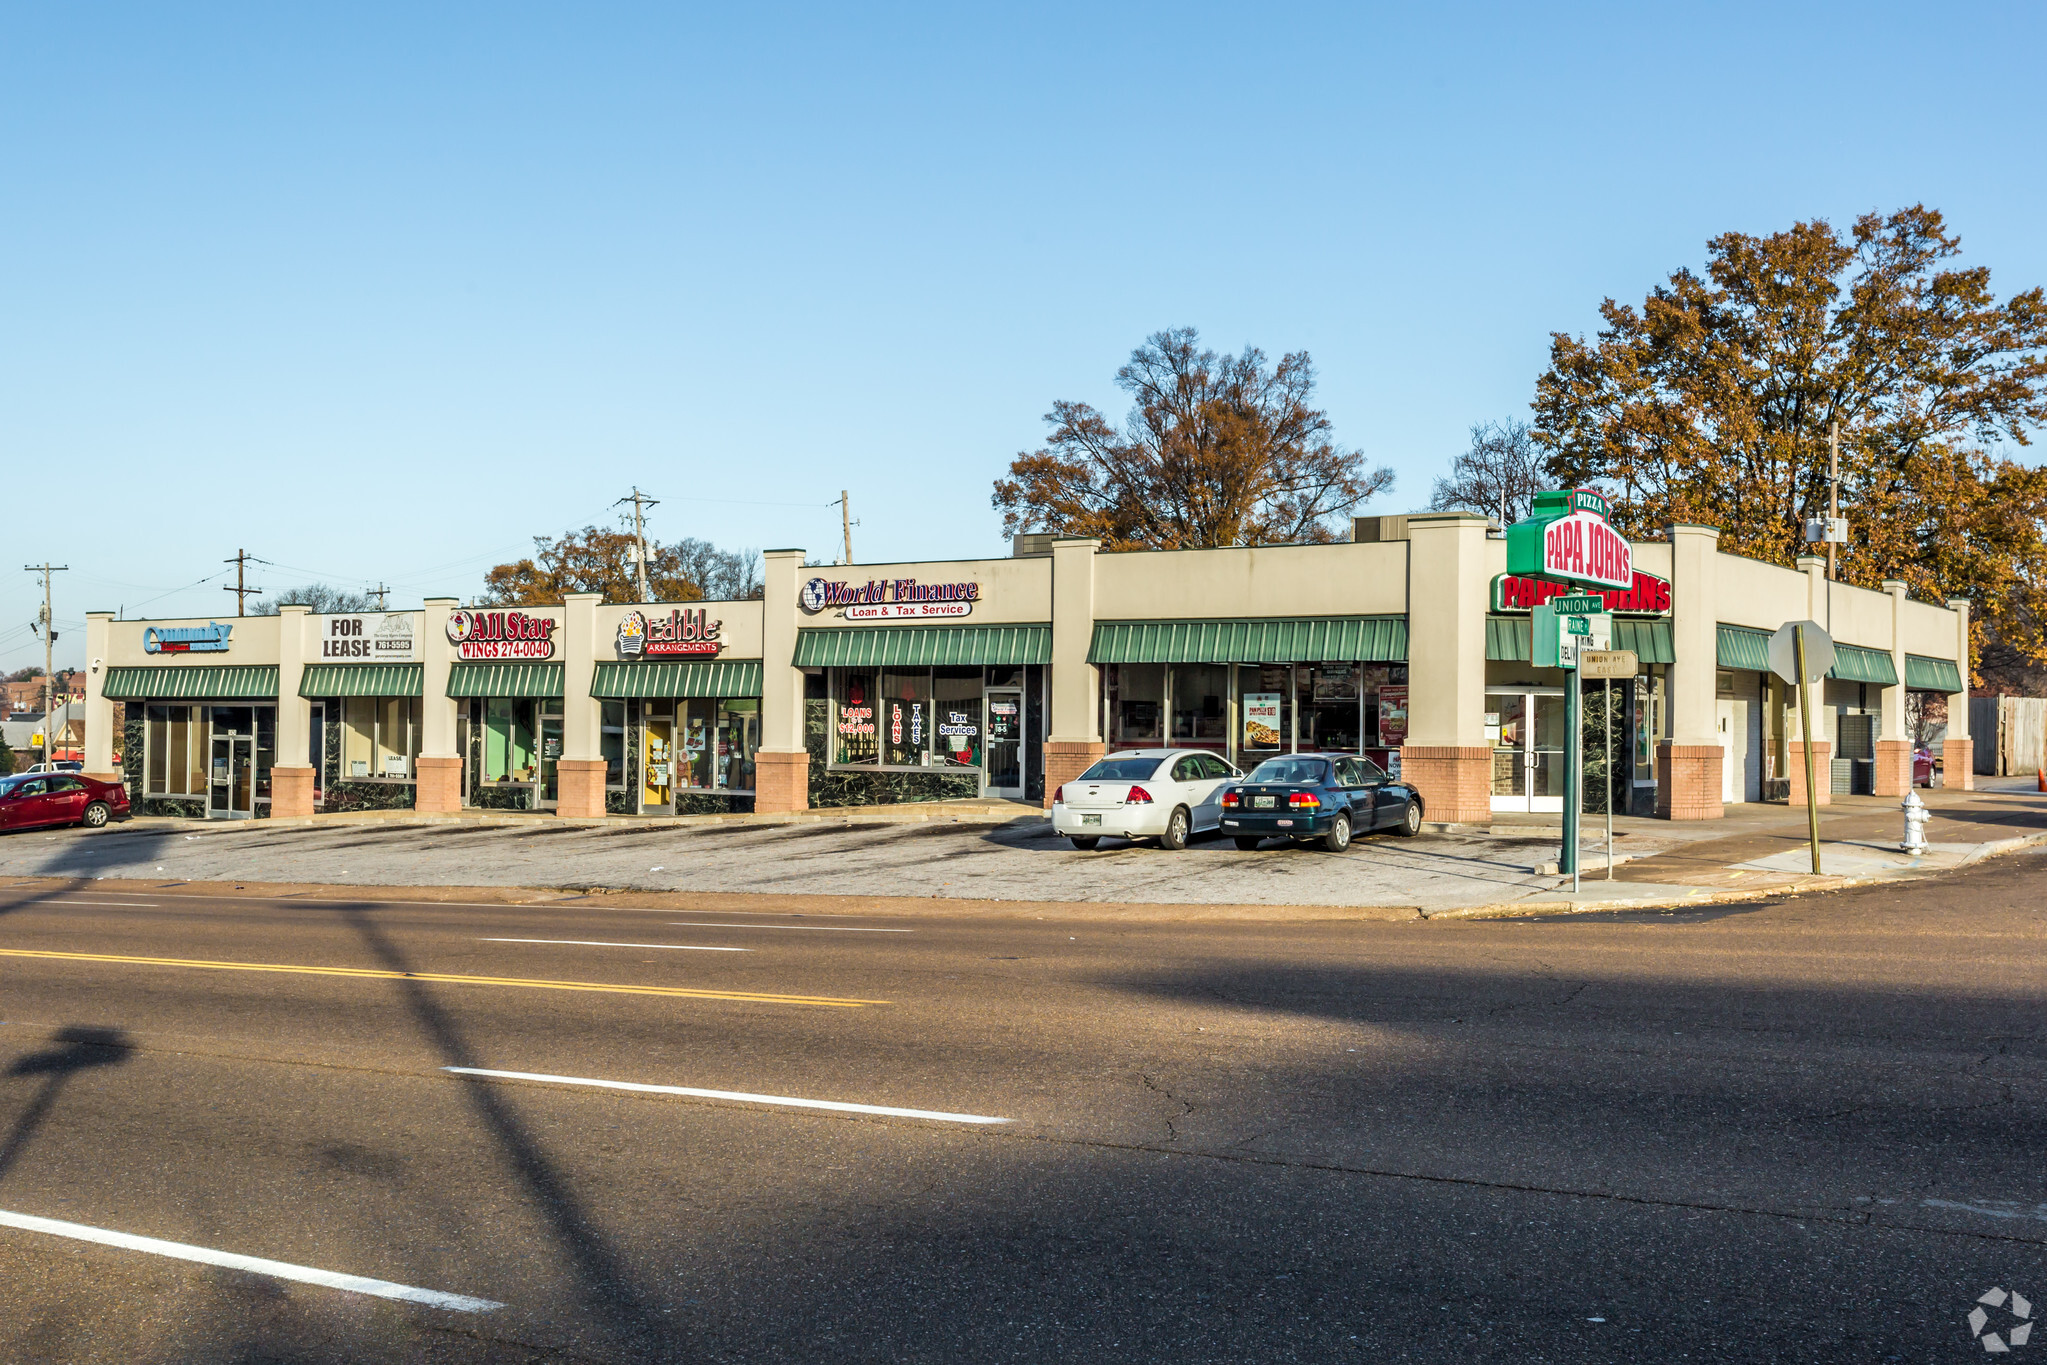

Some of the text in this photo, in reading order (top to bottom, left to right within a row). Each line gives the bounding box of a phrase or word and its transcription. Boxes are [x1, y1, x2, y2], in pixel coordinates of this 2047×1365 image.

[1576, 493, 1603, 513] PIZZA
[1547, 520, 1630, 584] PAPA JOHN'S
[822, 577, 979, 605] World Finance
[852, 605, 964, 617] Loan & Tax Service
[1555, 600, 1602, 612] UNION AVE
[331, 619, 363, 637] FOR
[470, 612, 503, 640] All
[506, 612, 552, 640] Star
[648, 609, 716, 641] Edible
[323, 639, 371, 657] LEASE
[377, 641, 410, 649] 761-5595
[462, 640, 549, 658] WINGS 274-0040
[648, 643, 717, 652] ARRANGEMENTS
[843, 708, 872, 718] LOANS
[950, 713, 967, 722] Tax
[840, 723, 875, 735] $12,000
[893, 705, 902, 743] LOANS
[940, 724, 976, 734] Services
